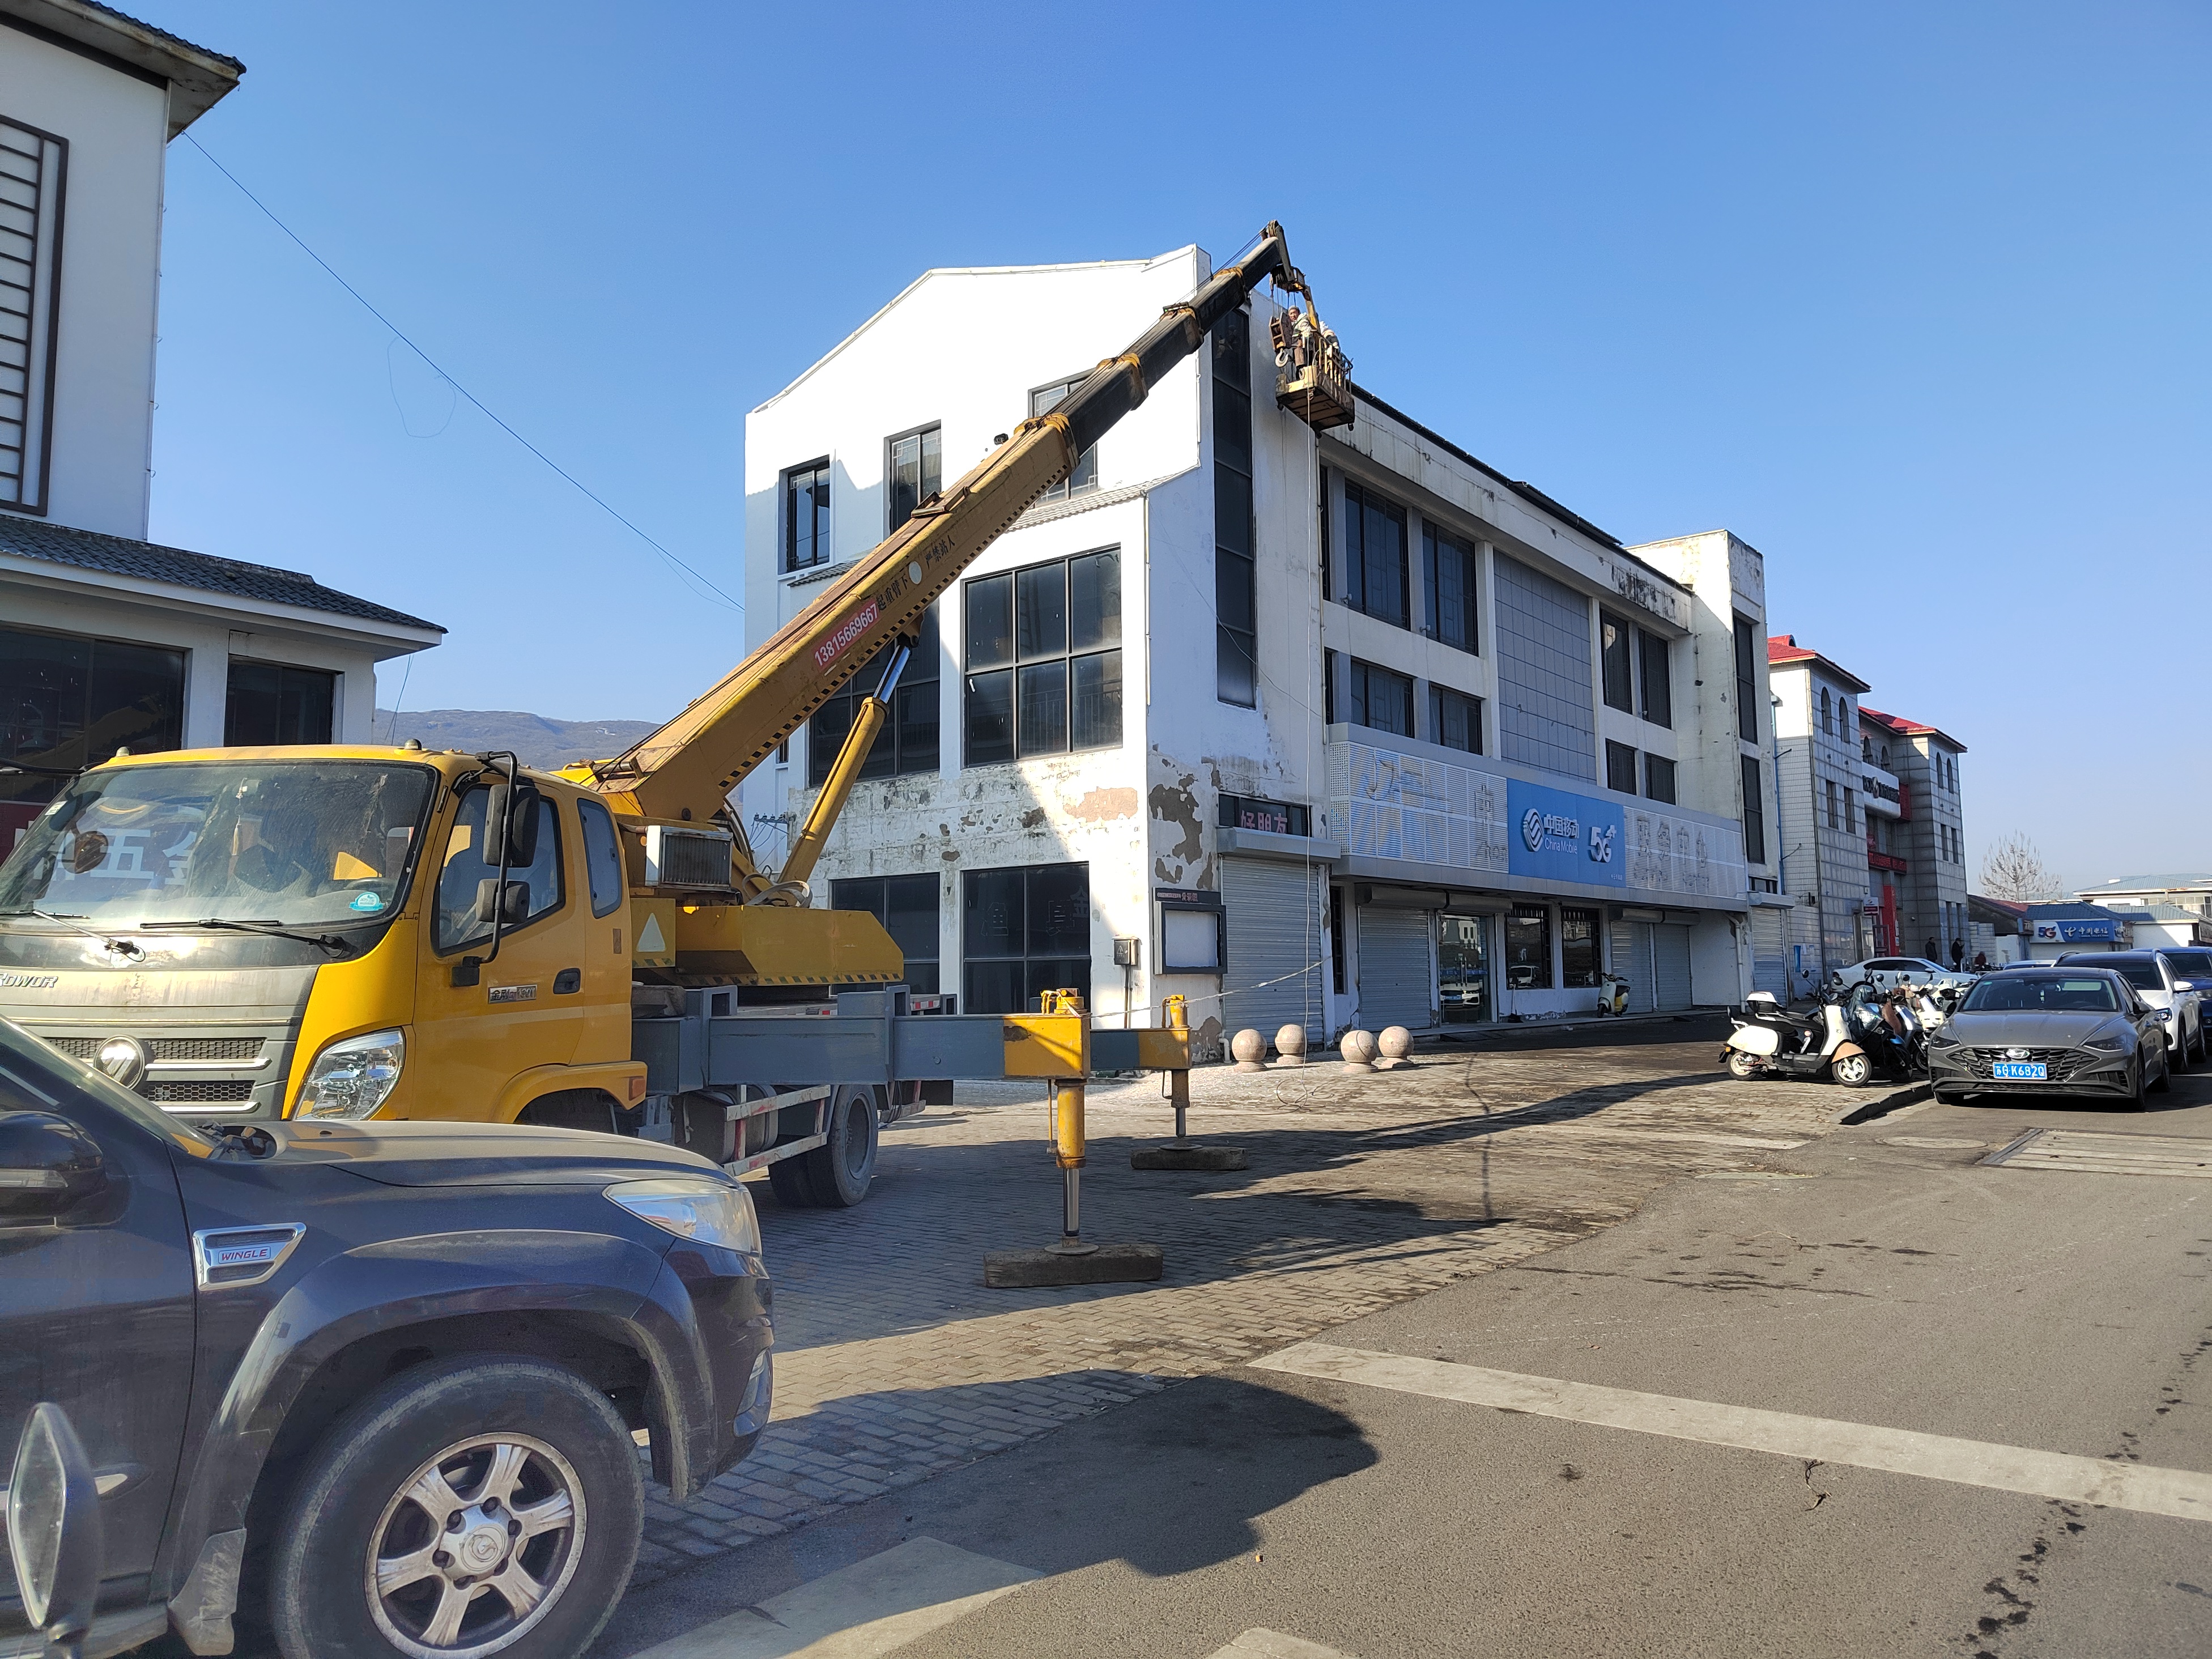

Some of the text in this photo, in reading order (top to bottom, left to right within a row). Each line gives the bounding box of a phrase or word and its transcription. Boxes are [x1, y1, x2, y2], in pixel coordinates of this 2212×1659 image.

[925, 535, 955, 570] 严禁站人
[815, 603, 878, 666] 13815669667
[1544, 814, 1579, 839] 中国移动
[1545, 837, 1577, 854] China Mobile
[2038, 926, 2056, 939] 5G
[222, 1249, 268, 1261] WINGLE
